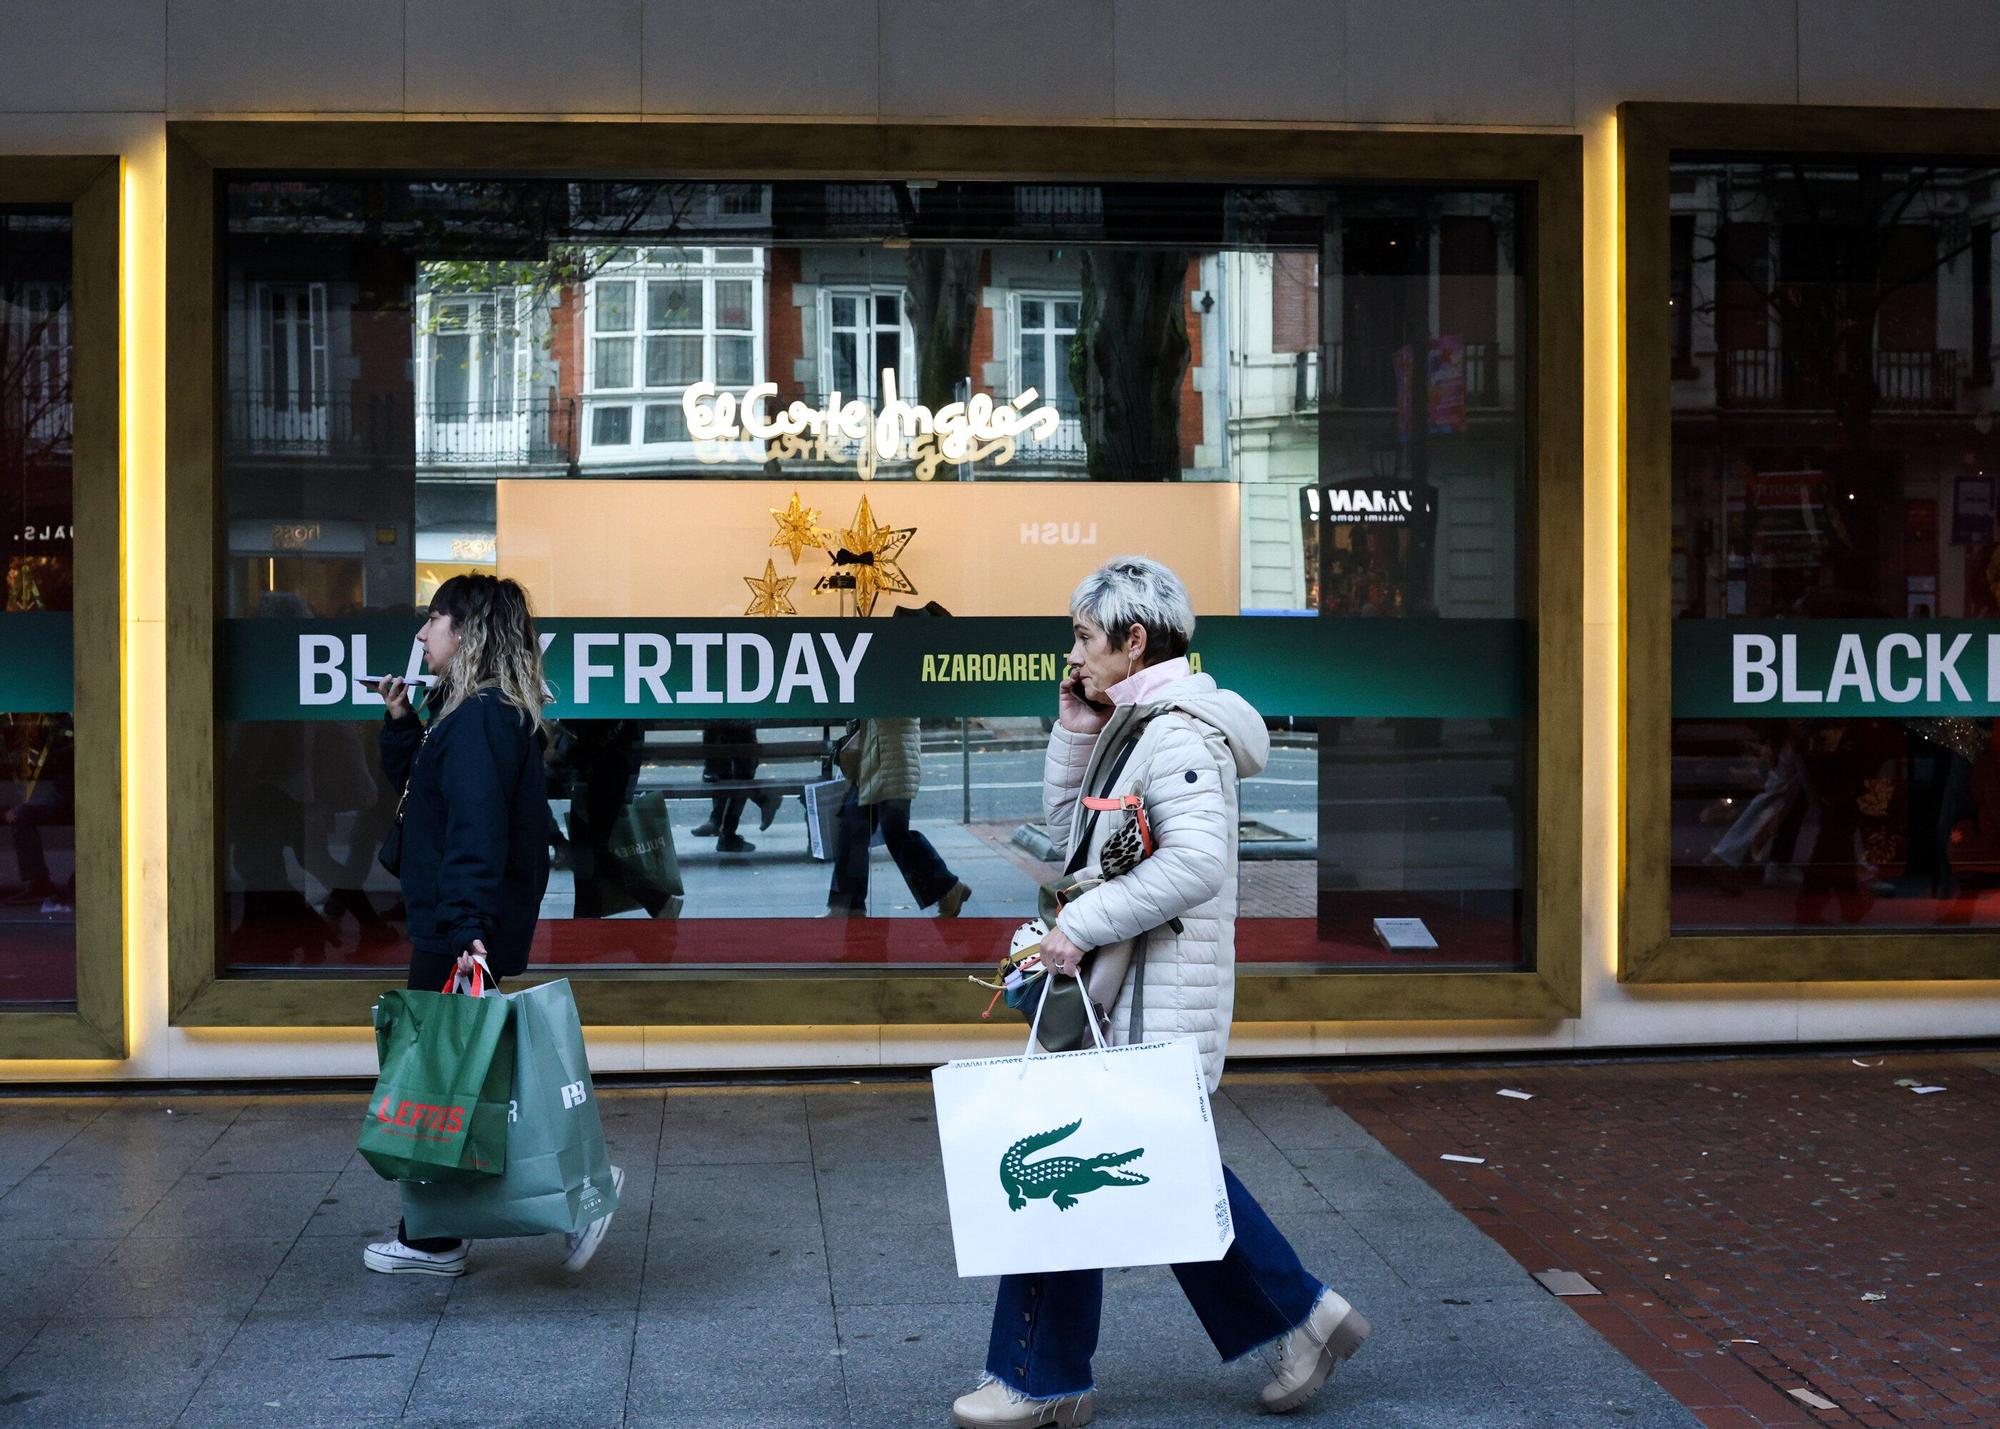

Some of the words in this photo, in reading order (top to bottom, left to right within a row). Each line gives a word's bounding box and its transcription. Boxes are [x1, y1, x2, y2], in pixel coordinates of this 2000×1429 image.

[682, 382, 741, 441] El
[740, 382, 867, 441] Corte
[875, 367, 1060, 460] Inglés
[573, 632, 874, 704] FRIDAY
[921, 653, 1056, 682] AZAROAREN
[1733, 632, 1973, 703] BLACK
